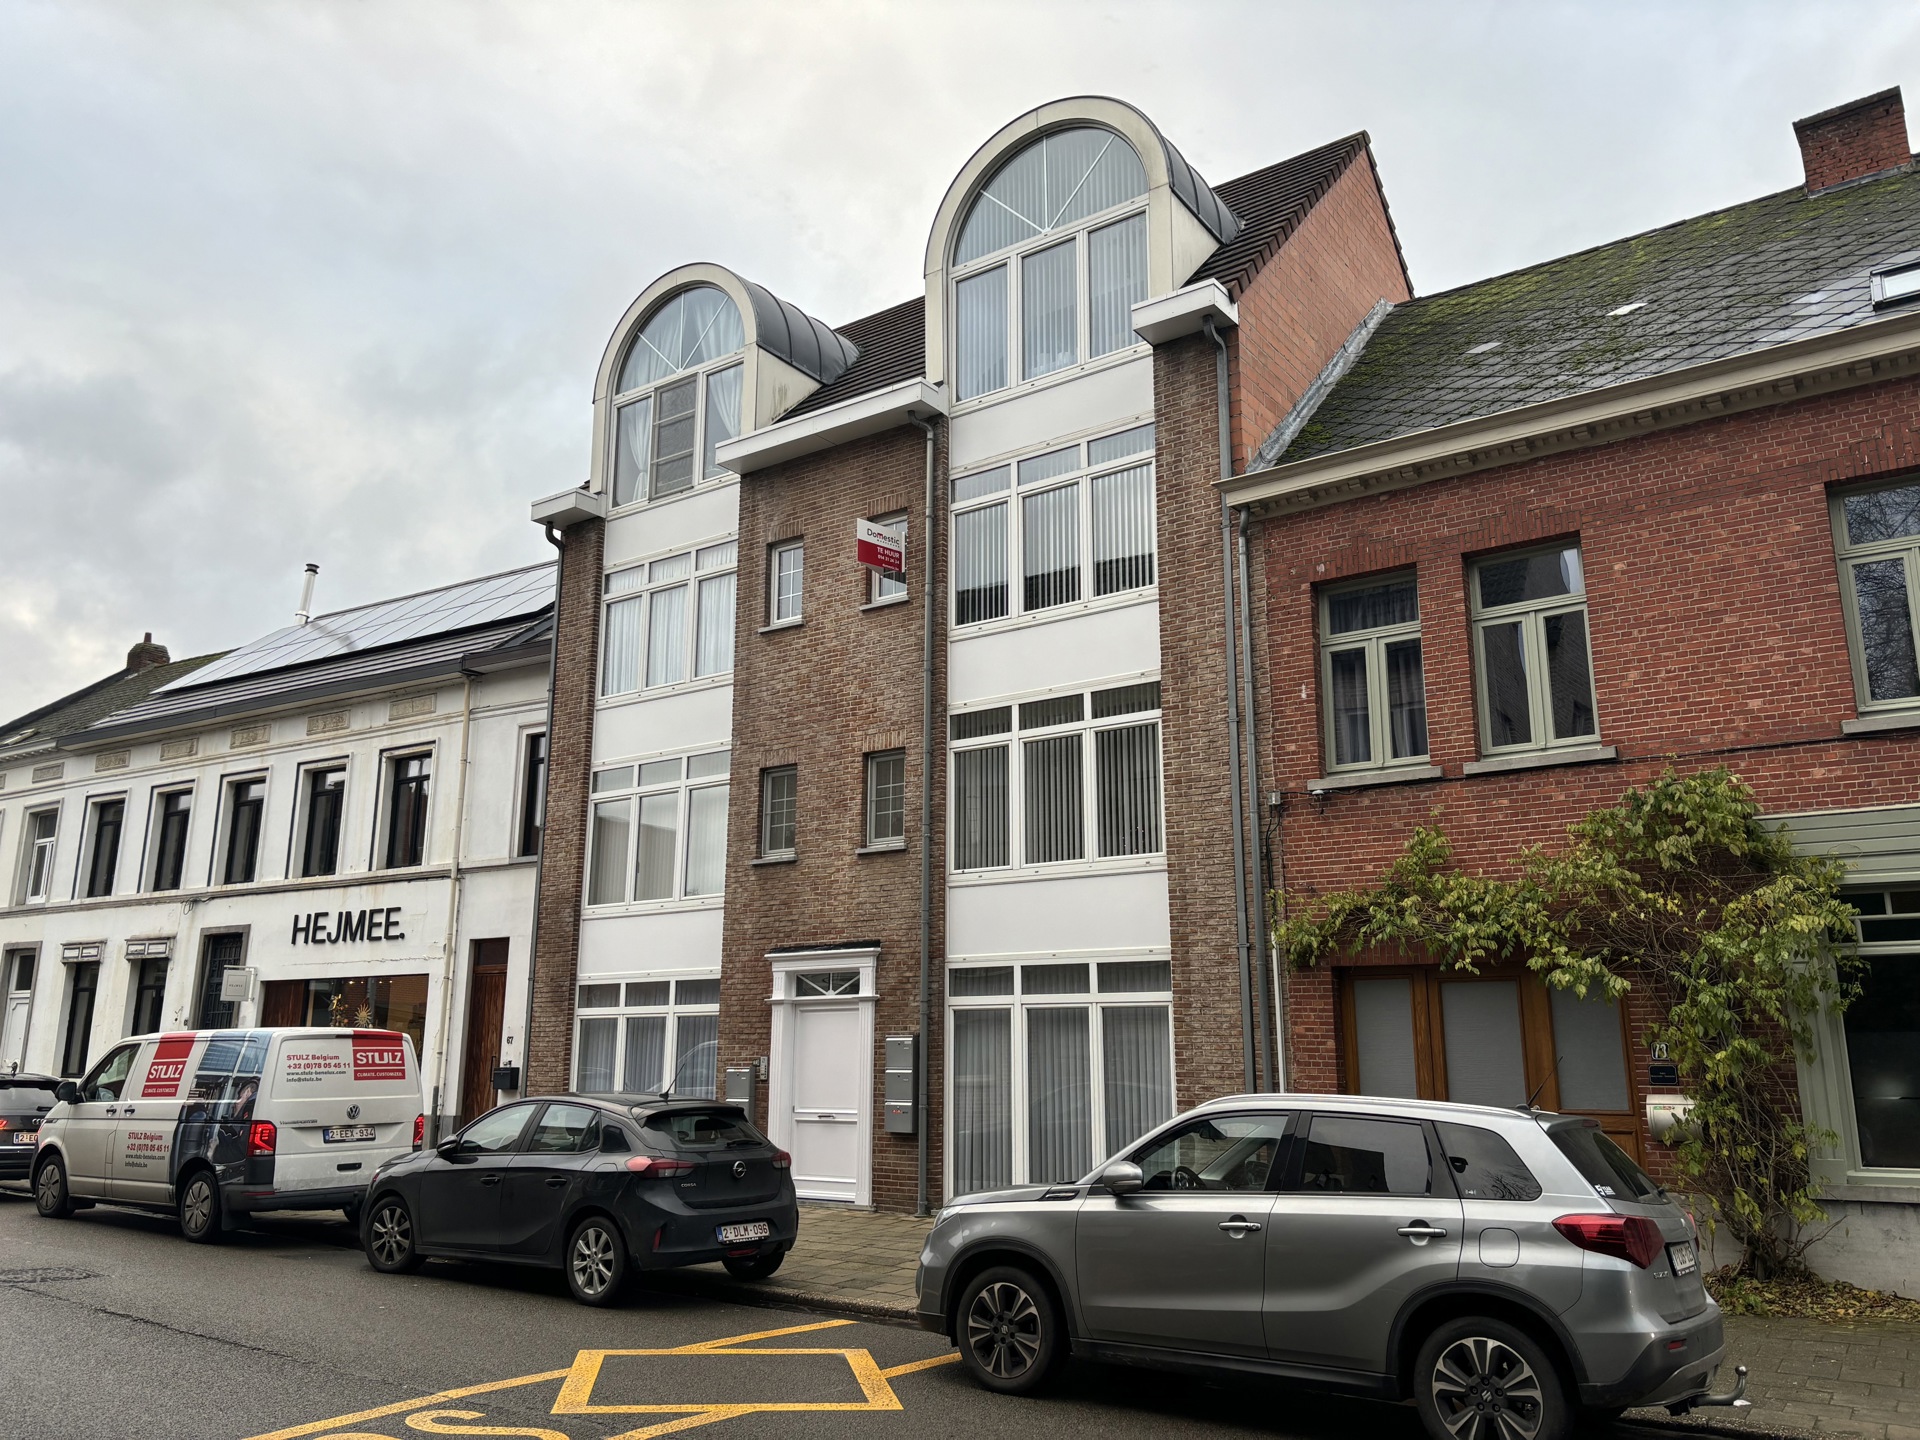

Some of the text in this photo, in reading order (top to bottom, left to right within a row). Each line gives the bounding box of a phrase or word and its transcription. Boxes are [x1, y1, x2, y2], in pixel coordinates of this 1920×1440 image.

[867, 528, 900, 545] Domestic
[877, 546, 900, 558] TE HUUR
[291, 907, 405, 945] HEJMEE.
[506, 1035, 514, 1045] 67
[311, 1053, 340, 1061] Belgium
[356, 1051, 403, 1065] STULZ
[149, 1064, 184, 1079] STULZ
[303, 1062, 322, 1070] (0)78
[128, 1132, 143, 1140] STULZ
[722, 1223, 768, 1240] 2-DLM-096
